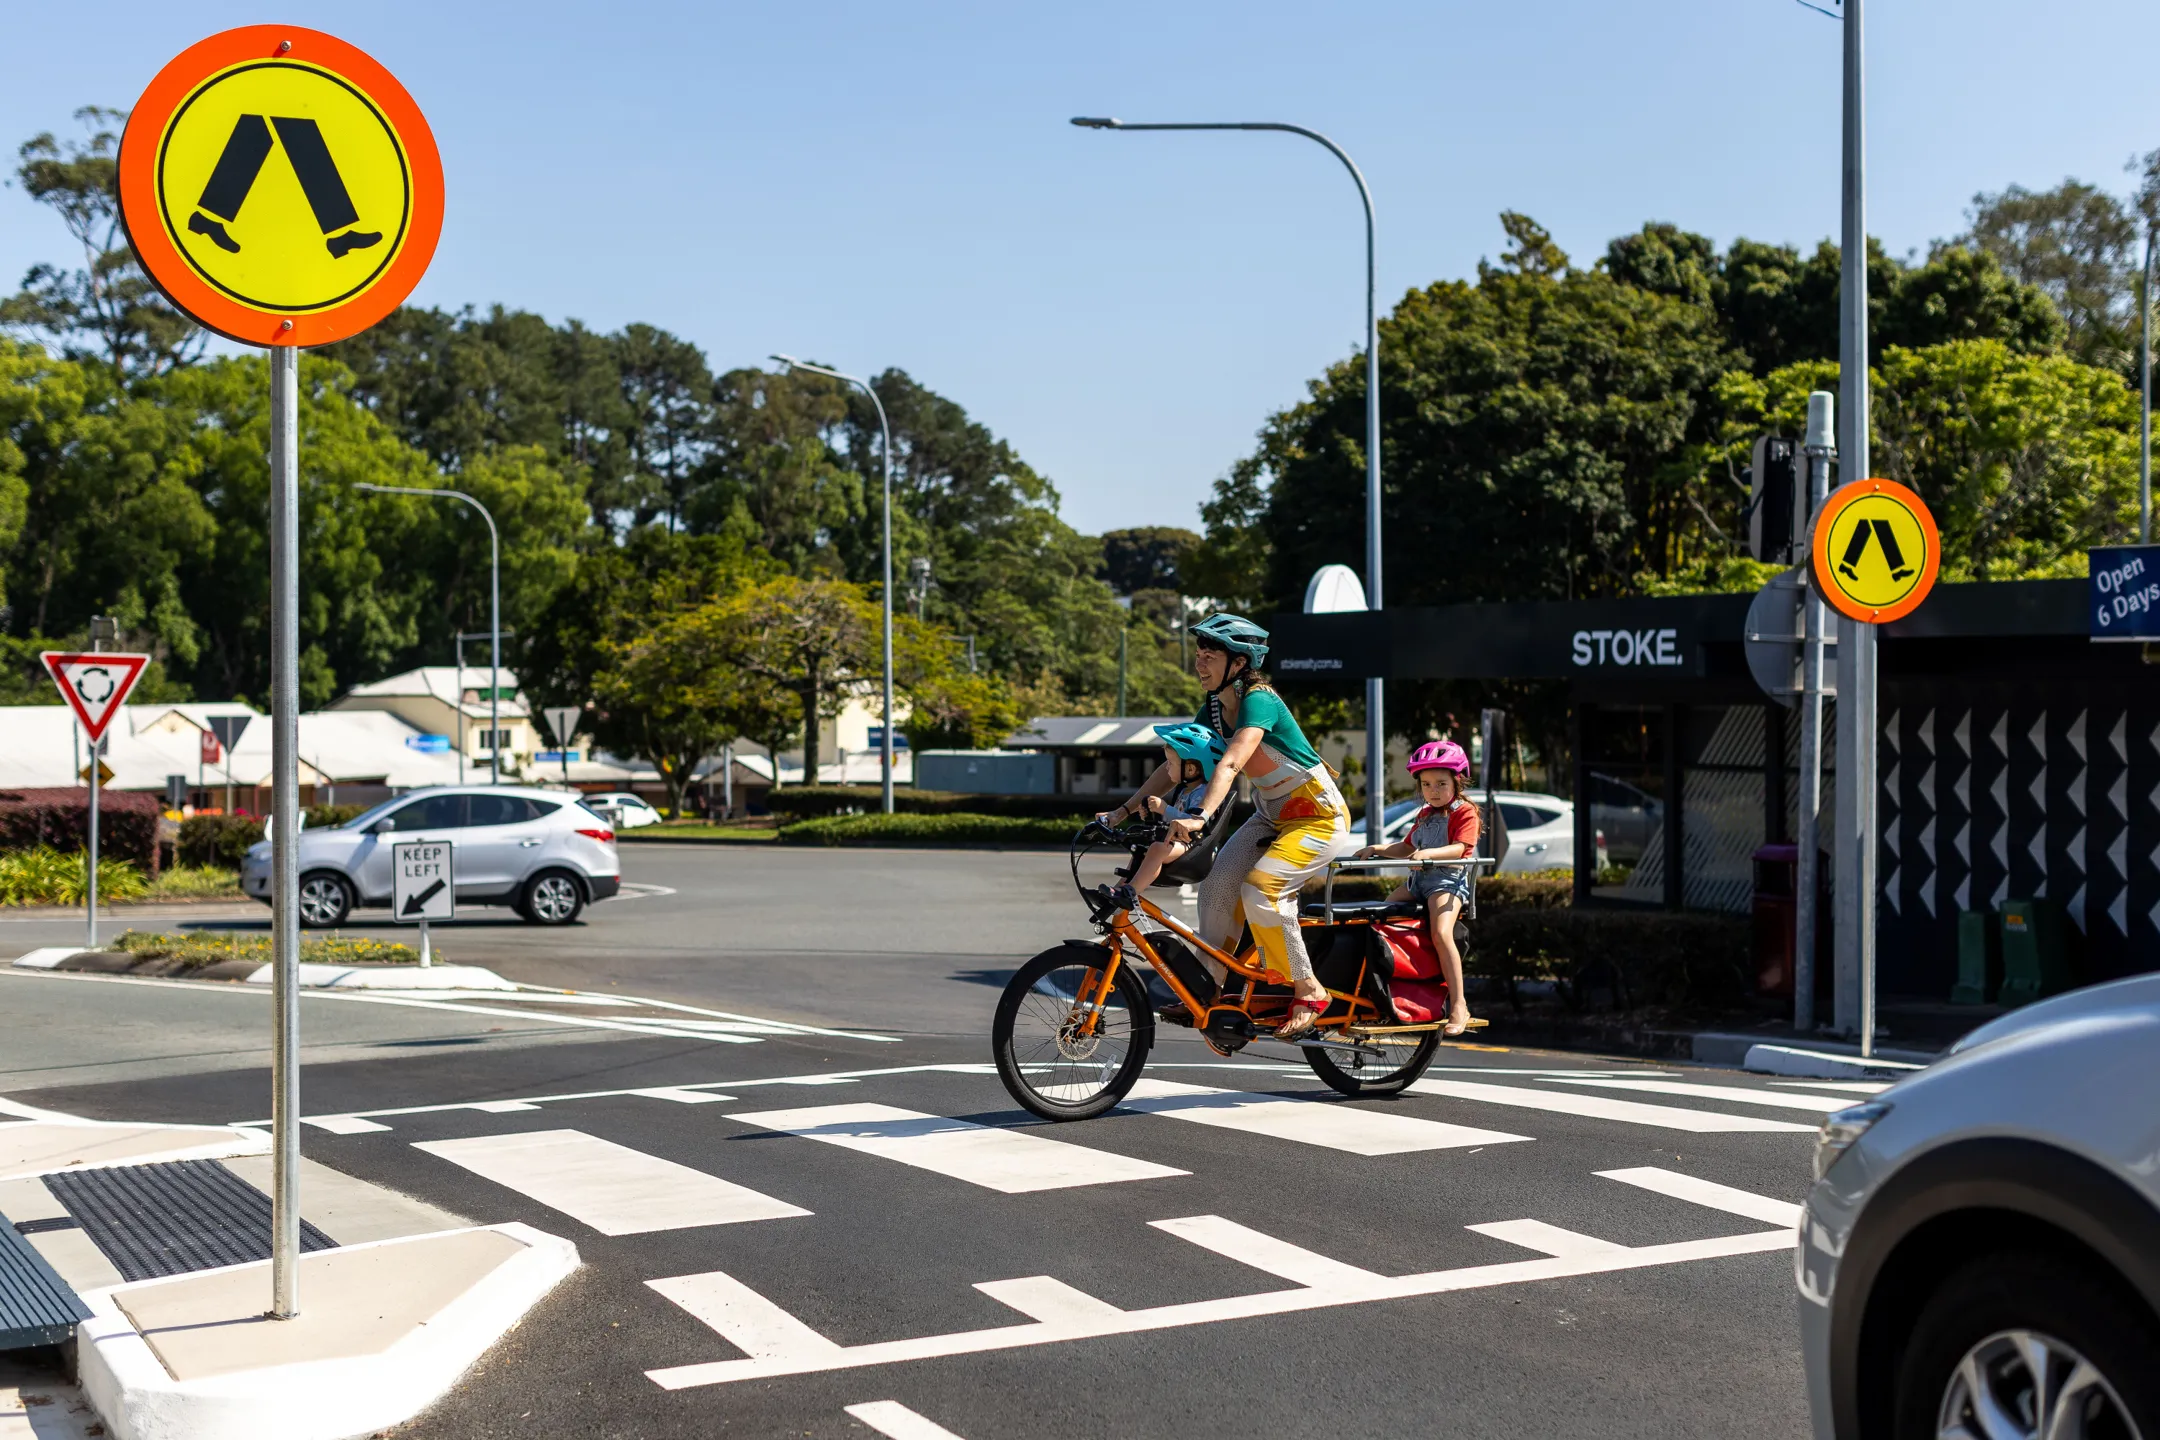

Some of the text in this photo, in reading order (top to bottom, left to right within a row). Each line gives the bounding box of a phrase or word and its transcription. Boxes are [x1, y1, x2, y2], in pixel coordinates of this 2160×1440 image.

[2096, 557, 2146, 593] Open
[2097, 583, 2160, 627] 6 Days
[1572, 628, 1683, 666] STOKE.
[403, 847, 442, 861] KEEP
[405, 863, 441, 877] LEFT
